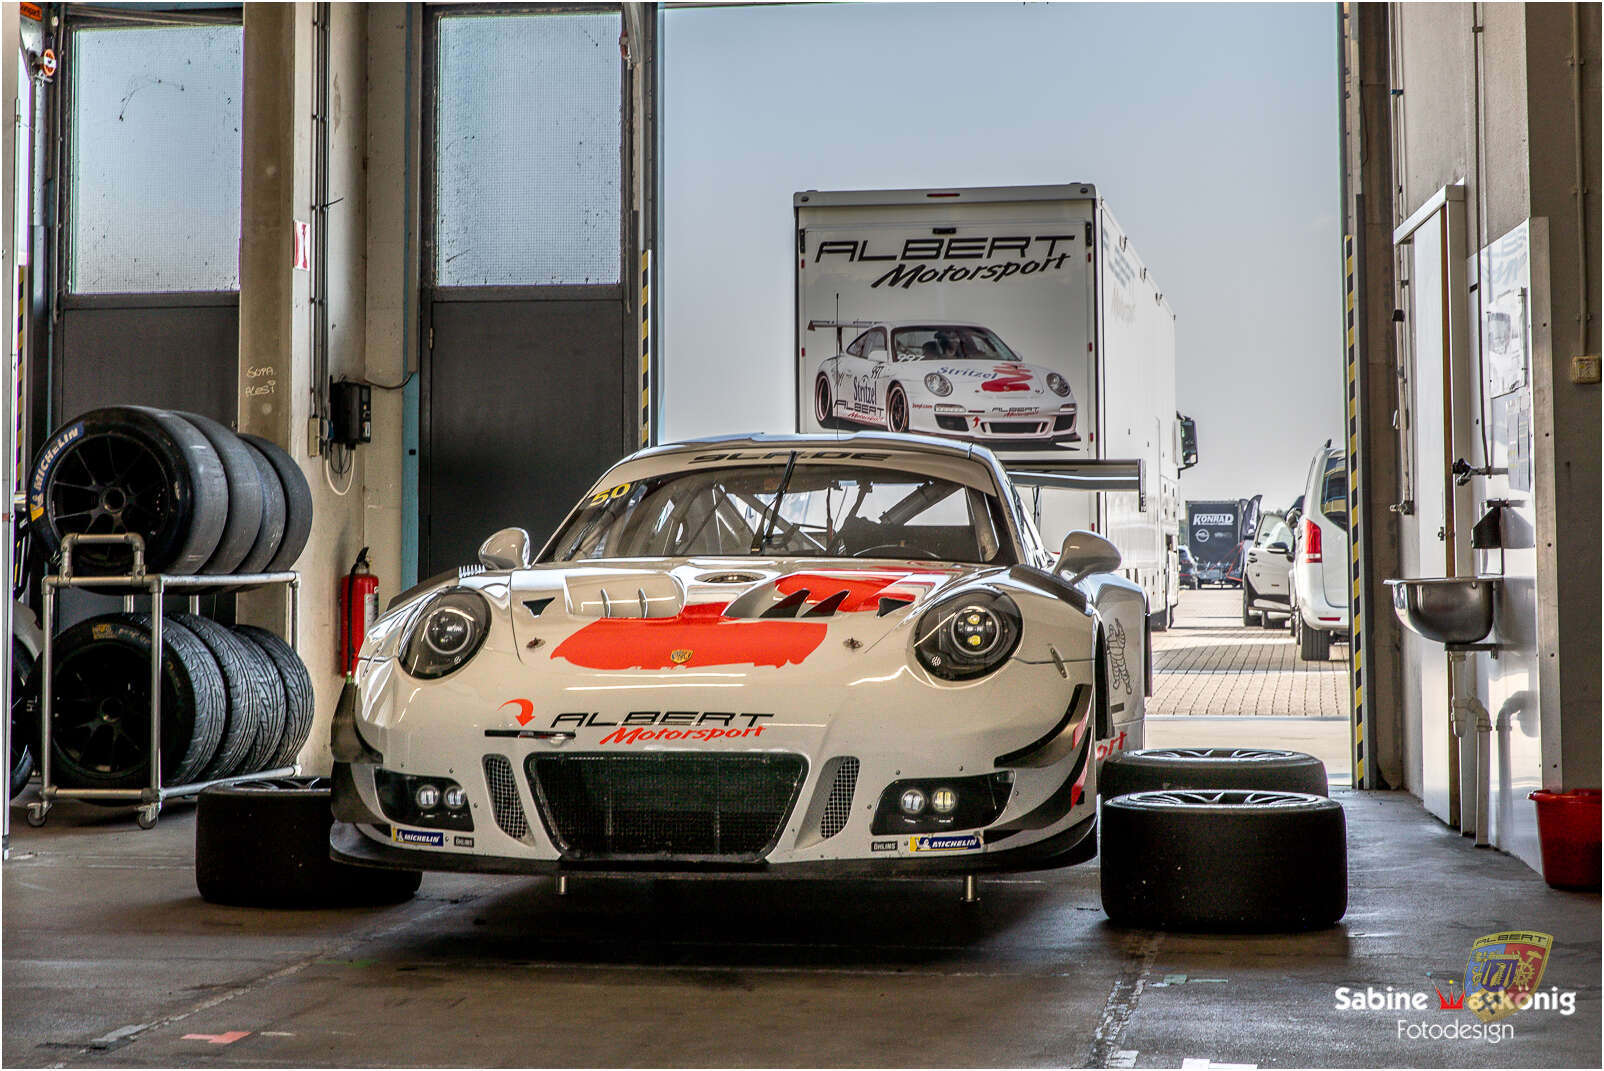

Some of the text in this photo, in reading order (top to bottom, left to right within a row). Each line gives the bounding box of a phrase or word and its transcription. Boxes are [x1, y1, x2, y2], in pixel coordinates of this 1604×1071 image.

[815, 235, 1075, 263] ALBERT
[871, 252, 1071, 289] Motorsport
[936, 366, 998, 380] Stritzel
[834, 399, 885, 417] ALBERT
[33, 427, 79, 491] MICHELIN
[591, 483, 630, 506] 50
[1193, 513, 1234, 526] KONRAD
[550, 711, 775, 728] ALBERT
[600, 725, 767, 745] Motorsport
[404, 833, 441, 843] MICHELIN
[931, 838, 978, 849] MICHELIN
